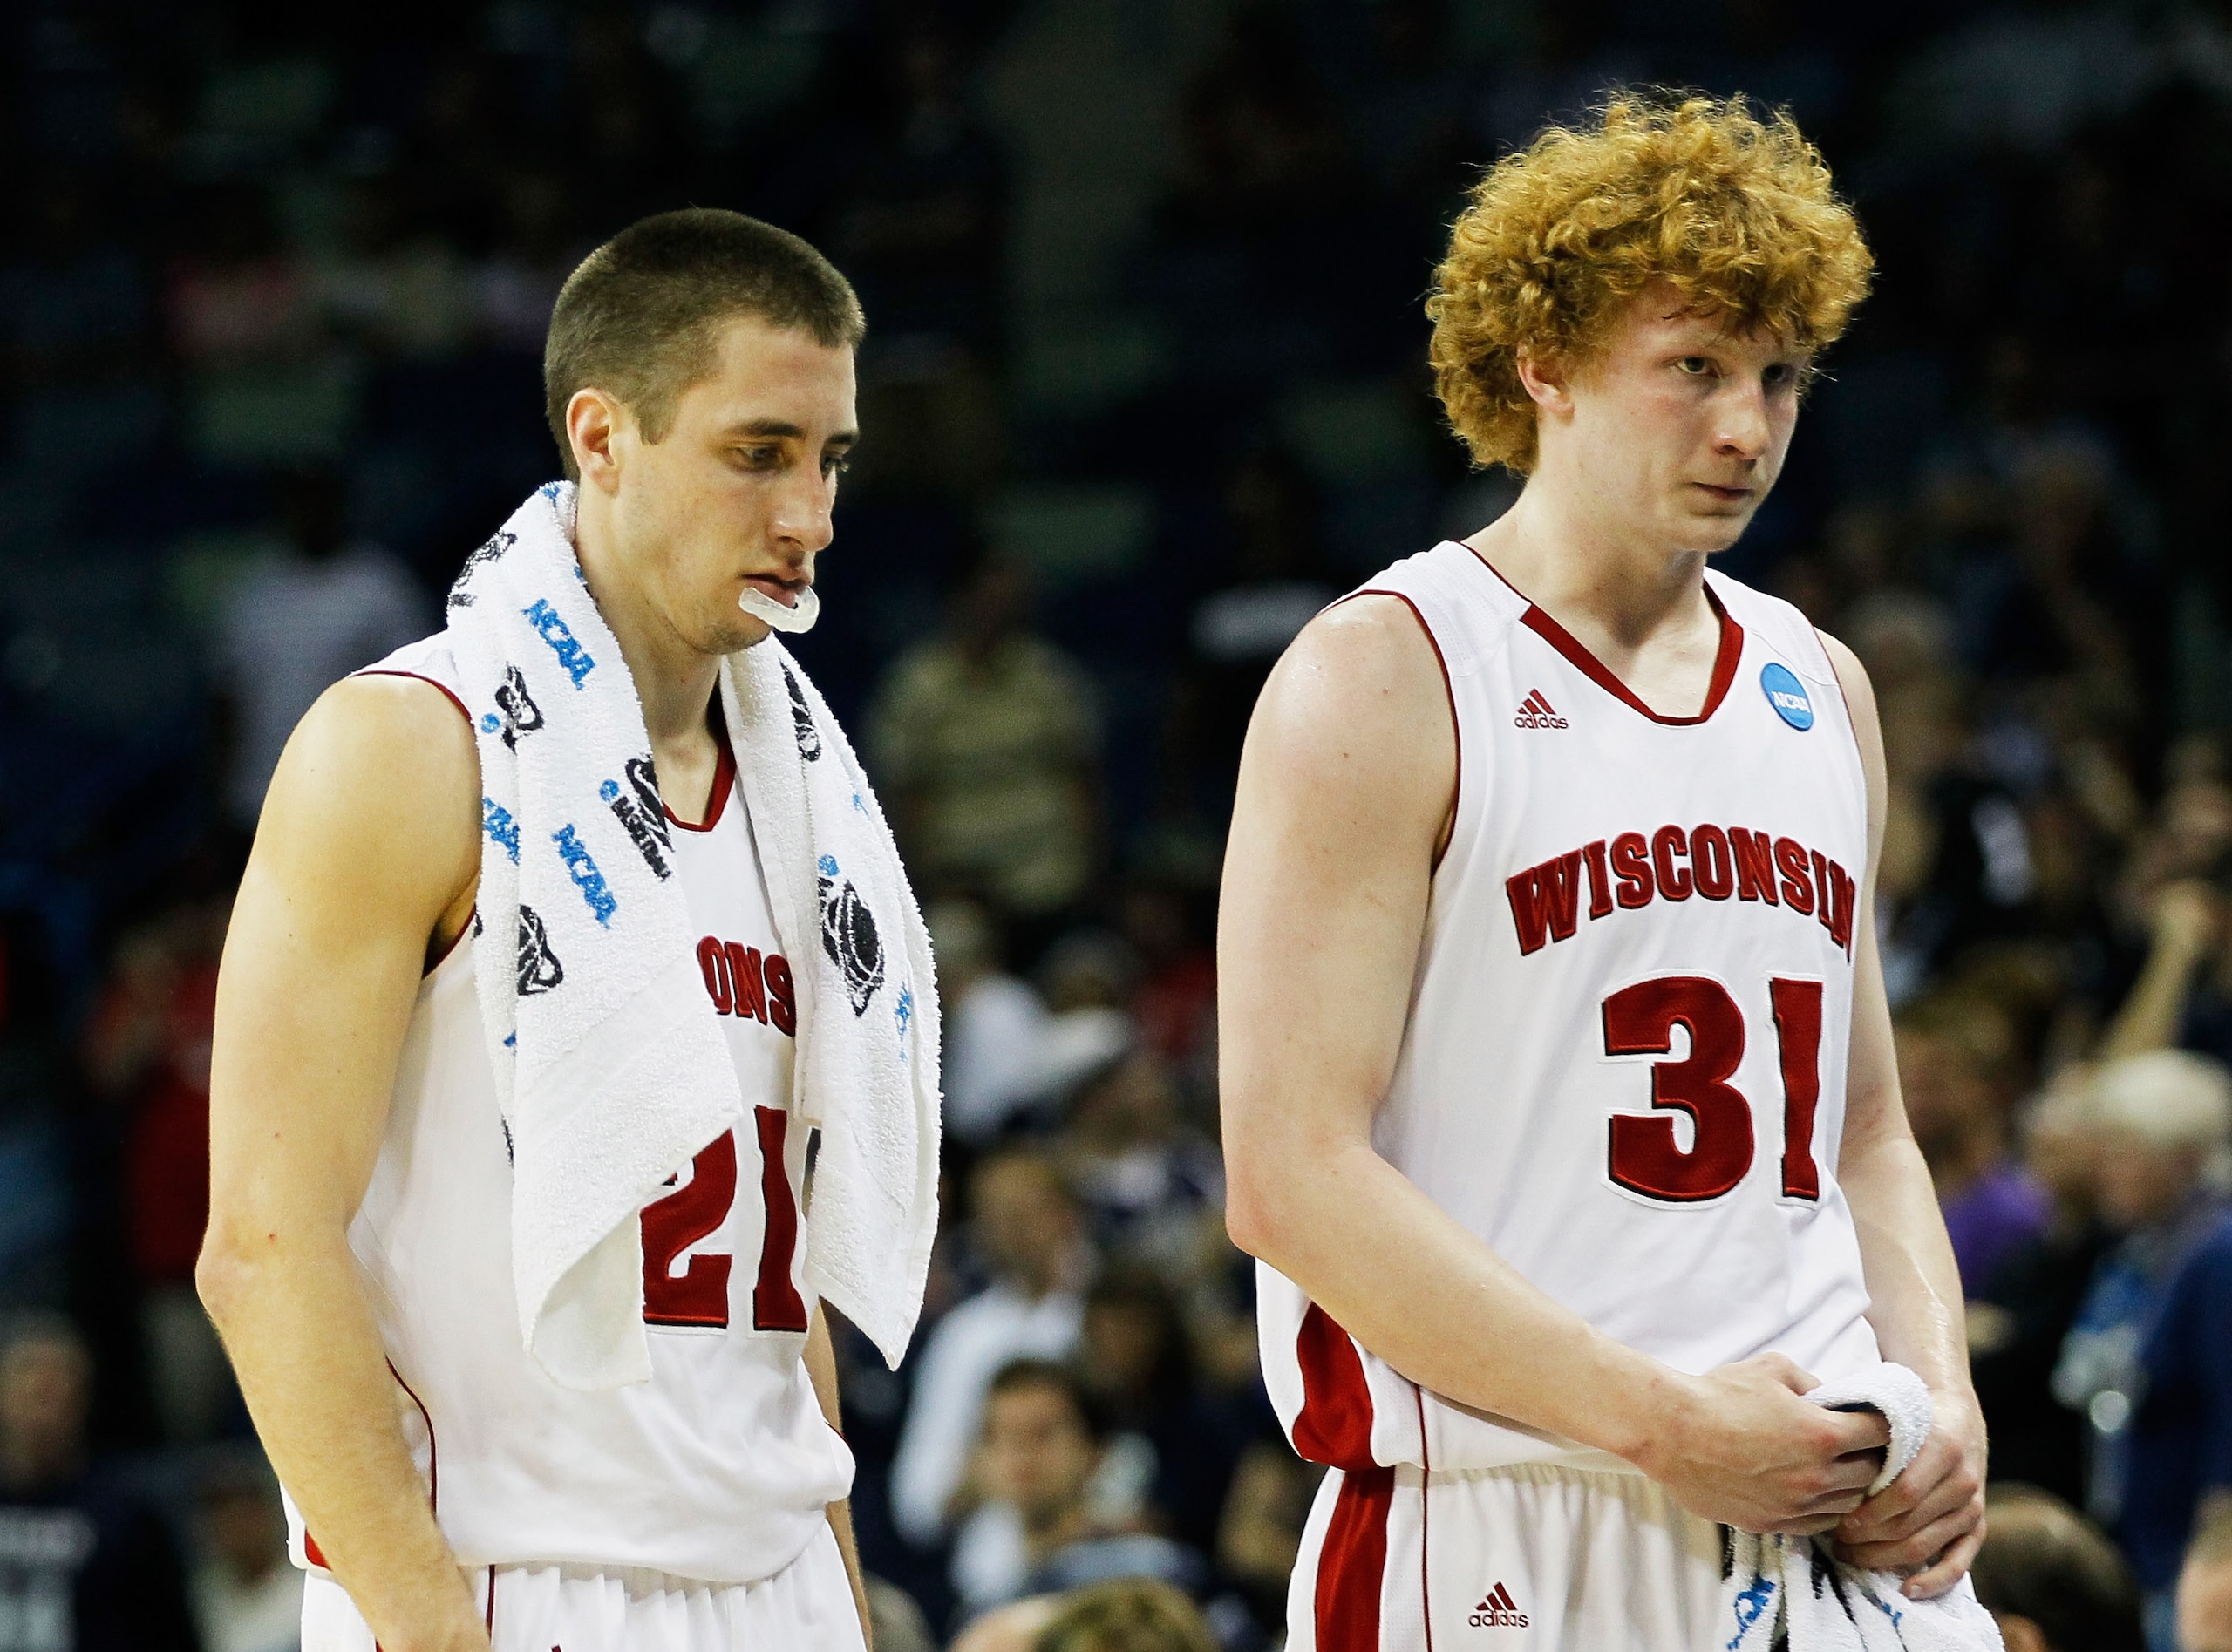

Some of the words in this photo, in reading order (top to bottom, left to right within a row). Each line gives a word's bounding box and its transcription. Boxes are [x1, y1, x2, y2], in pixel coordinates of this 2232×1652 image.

[1514, 713, 1569, 729] adidas
[1771, 690, 1812, 714] NCAA
[1507, 824, 1856, 963] WISCONSIN
[1602, 976, 1823, 1201] 31
[639, 1105, 807, 1330] 21
[1468, 1609, 1530, 1628] adidas
